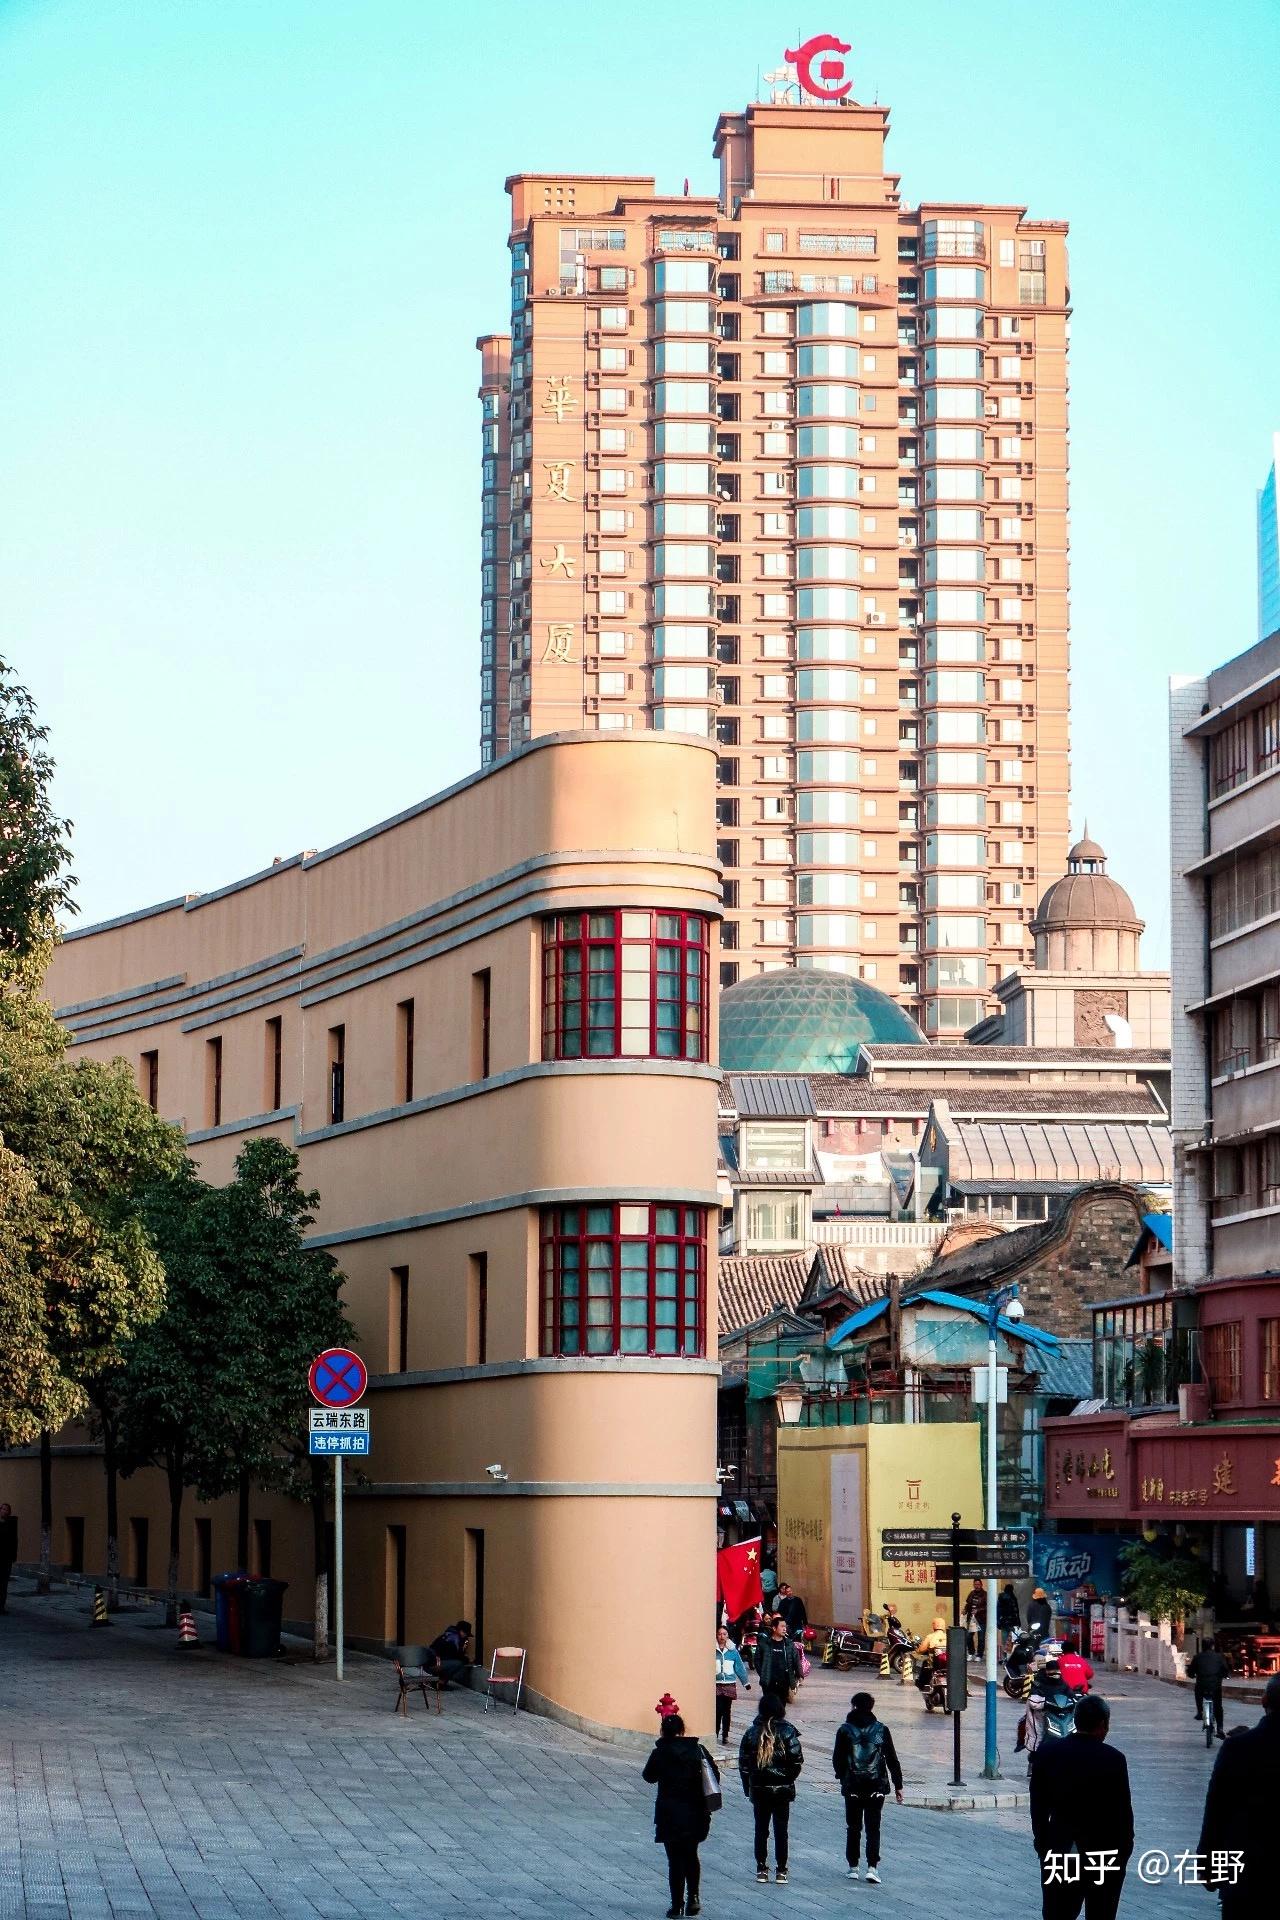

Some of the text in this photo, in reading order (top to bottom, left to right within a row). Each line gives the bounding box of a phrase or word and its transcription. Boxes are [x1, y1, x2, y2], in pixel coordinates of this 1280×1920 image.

[313, 1413, 365, 1428] 云瑞东路
[314, 1436, 365, 1450] 违停抓拍
[1046, 1552, 1091, 1580] 脉动
